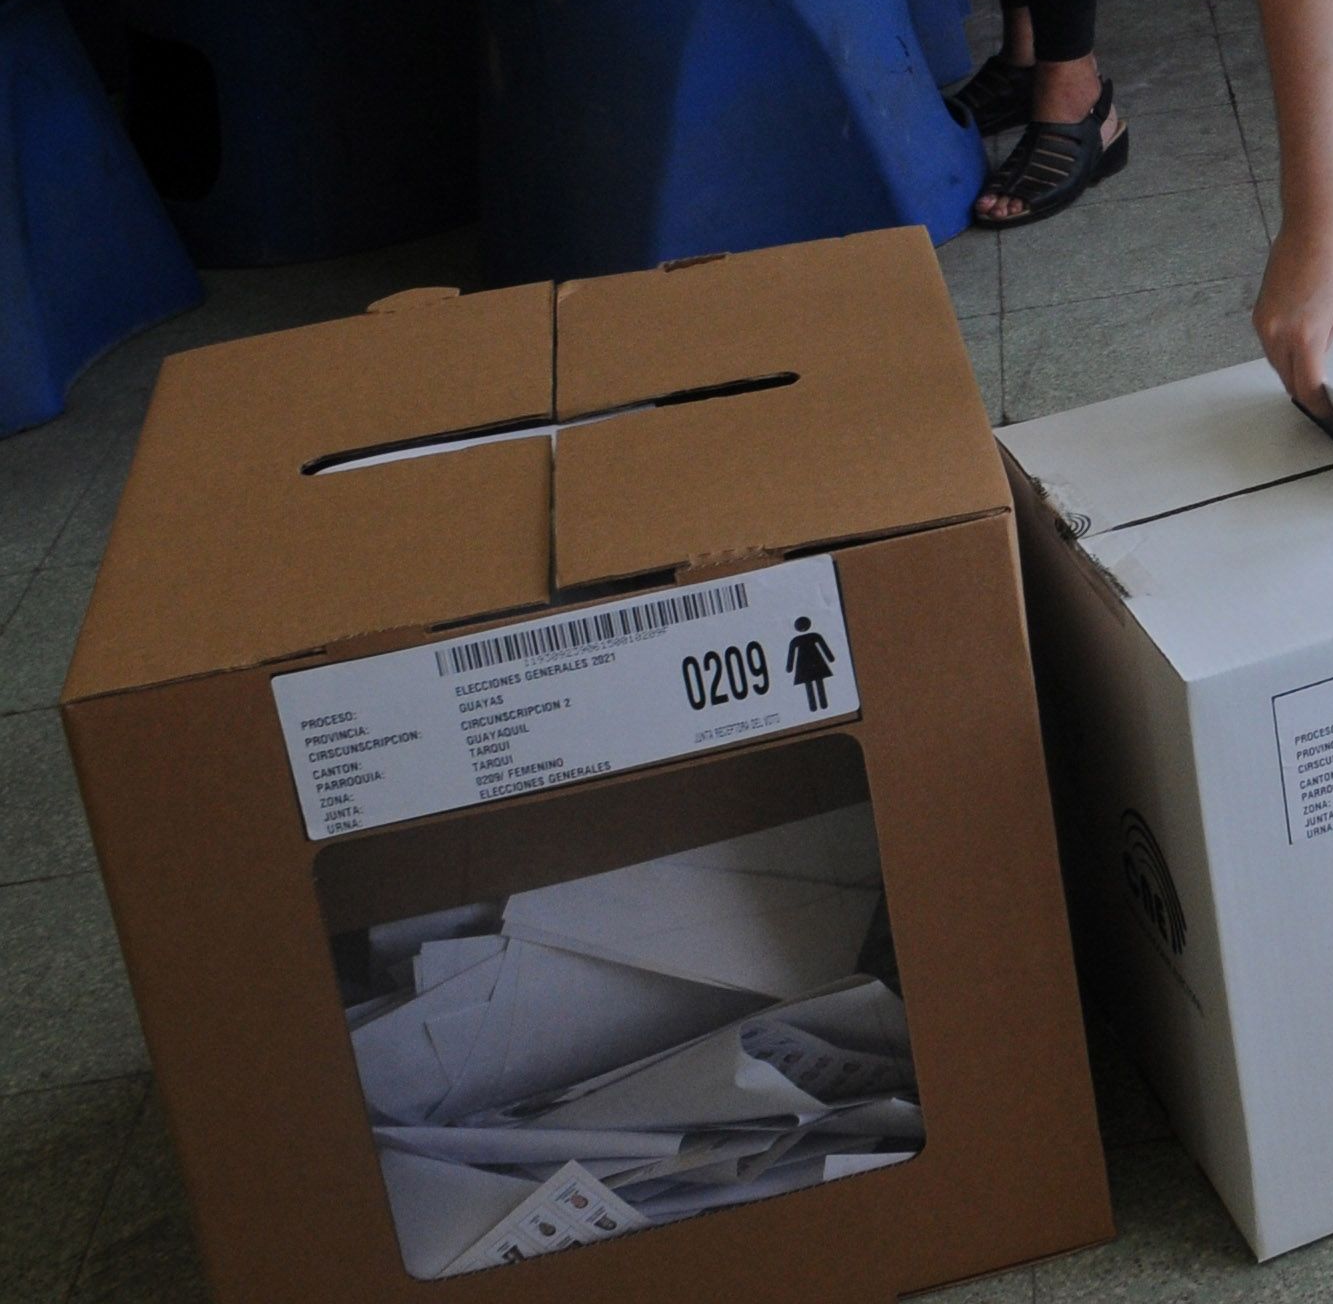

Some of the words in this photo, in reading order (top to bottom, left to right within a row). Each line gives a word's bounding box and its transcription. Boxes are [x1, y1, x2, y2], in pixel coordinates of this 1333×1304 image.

[455, 673, 521, 696] ELECCIONES
[525, 658, 588, 681] GENERALES
[592, 652, 616, 666] 2021
[682, 641, 769, 710] 0209
[459, 695, 504, 713] GUAYAS
[301, 711, 358, 731] PROCESO:
[461, 699, 560, 731] CIRCUNSCRIPCION
[564, 698, 571, 708] 2
[304, 727, 370, 747] PROVINCIA:
[466, 723, 530, 746] GUAYAQUIL
[469, 741, 511, 757] TARQUI
[313, 761, 363, 780] CANTON:
[472, 755, 513, 772] TARQUI
[508, 757, 564, 779] FEMENINO
[316, 771, 384, 793] PARROQUIA:
[480, 776, 545, 799] ELECCIONES
[549, 761, 612, 783] GENERALES
[320, 794, 354, 809] ZONA:
[1303, 799, 1332, 816] ZONA:
[324, 805, 363, 822] JUNTA:
[327, 818, 363, 835] URNA:
